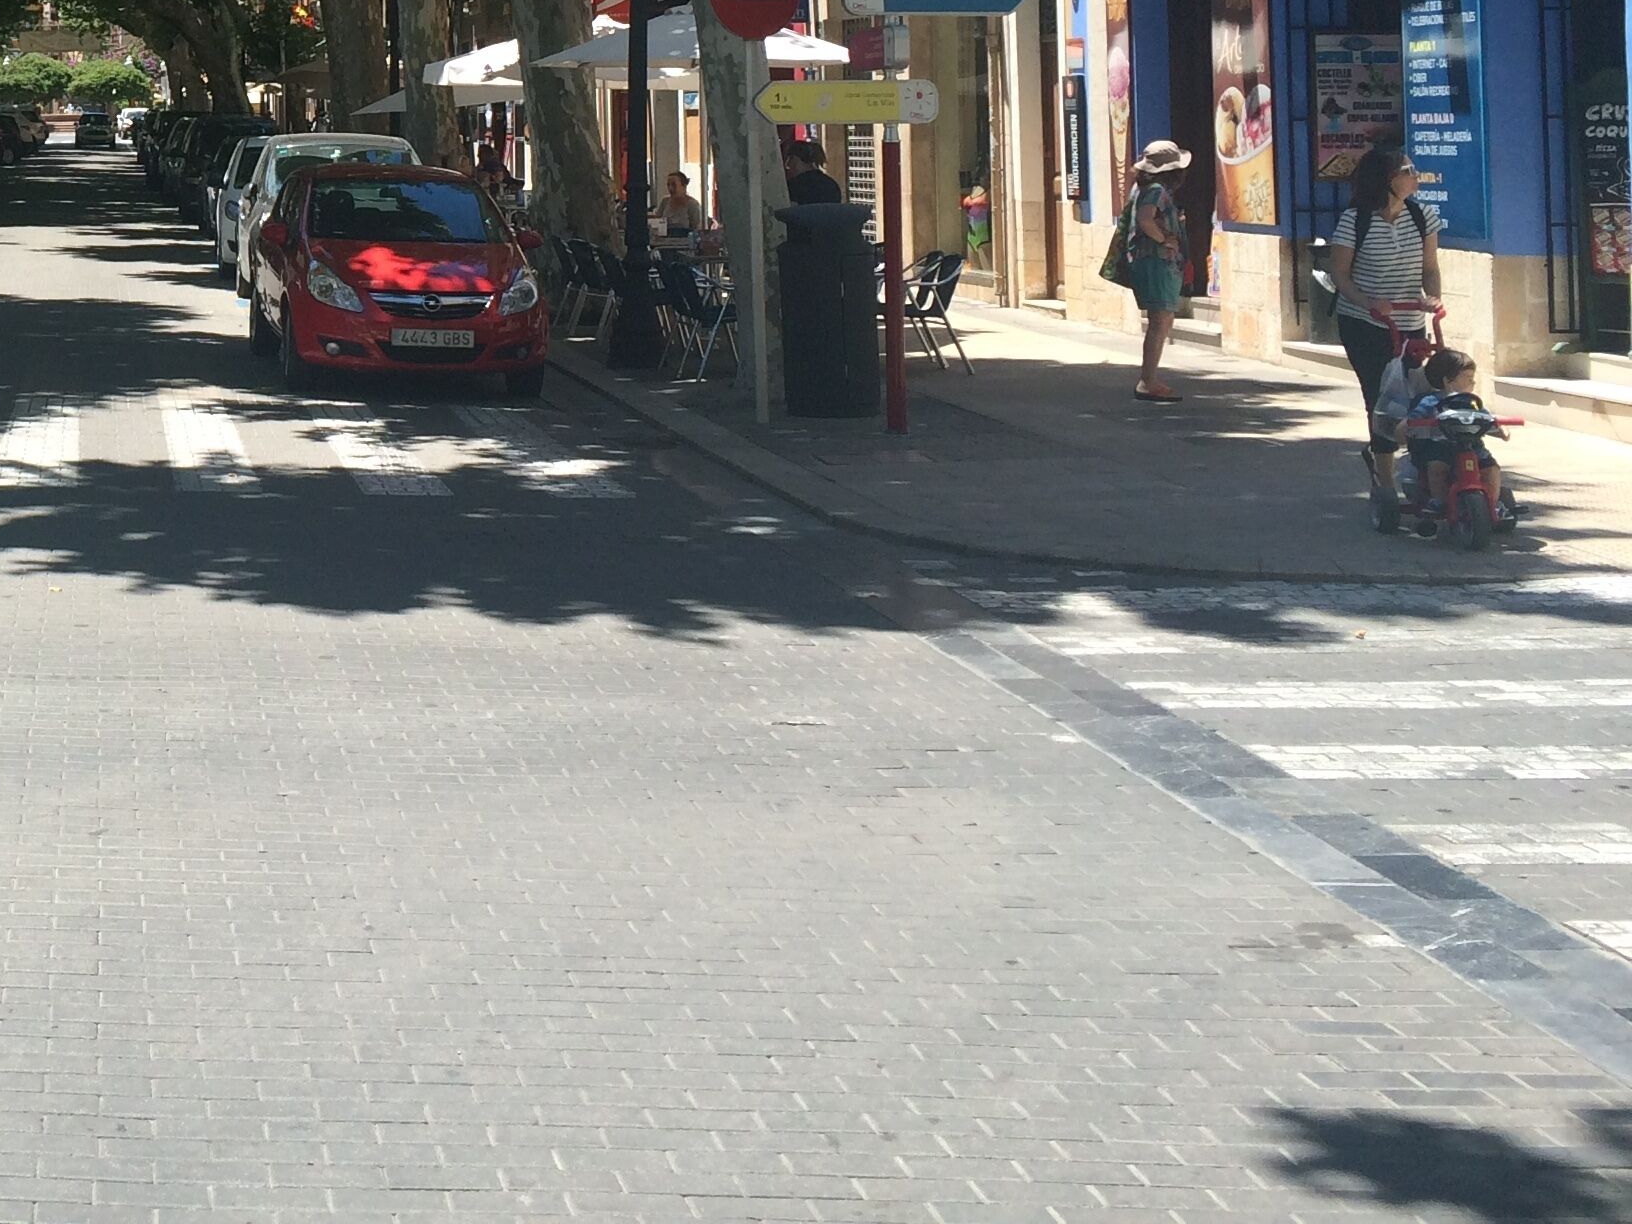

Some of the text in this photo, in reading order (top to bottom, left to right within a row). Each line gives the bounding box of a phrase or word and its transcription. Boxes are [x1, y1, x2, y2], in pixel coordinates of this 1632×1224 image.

[1412, 58, 1436, 70] INTERNET
[1411, 113, 1433, 125] PLANTA
[1416, 172, 1436, 184] LANTA
[1437, 190, 1448, 202] BAR
[443, 332, 471, 346] GBS
